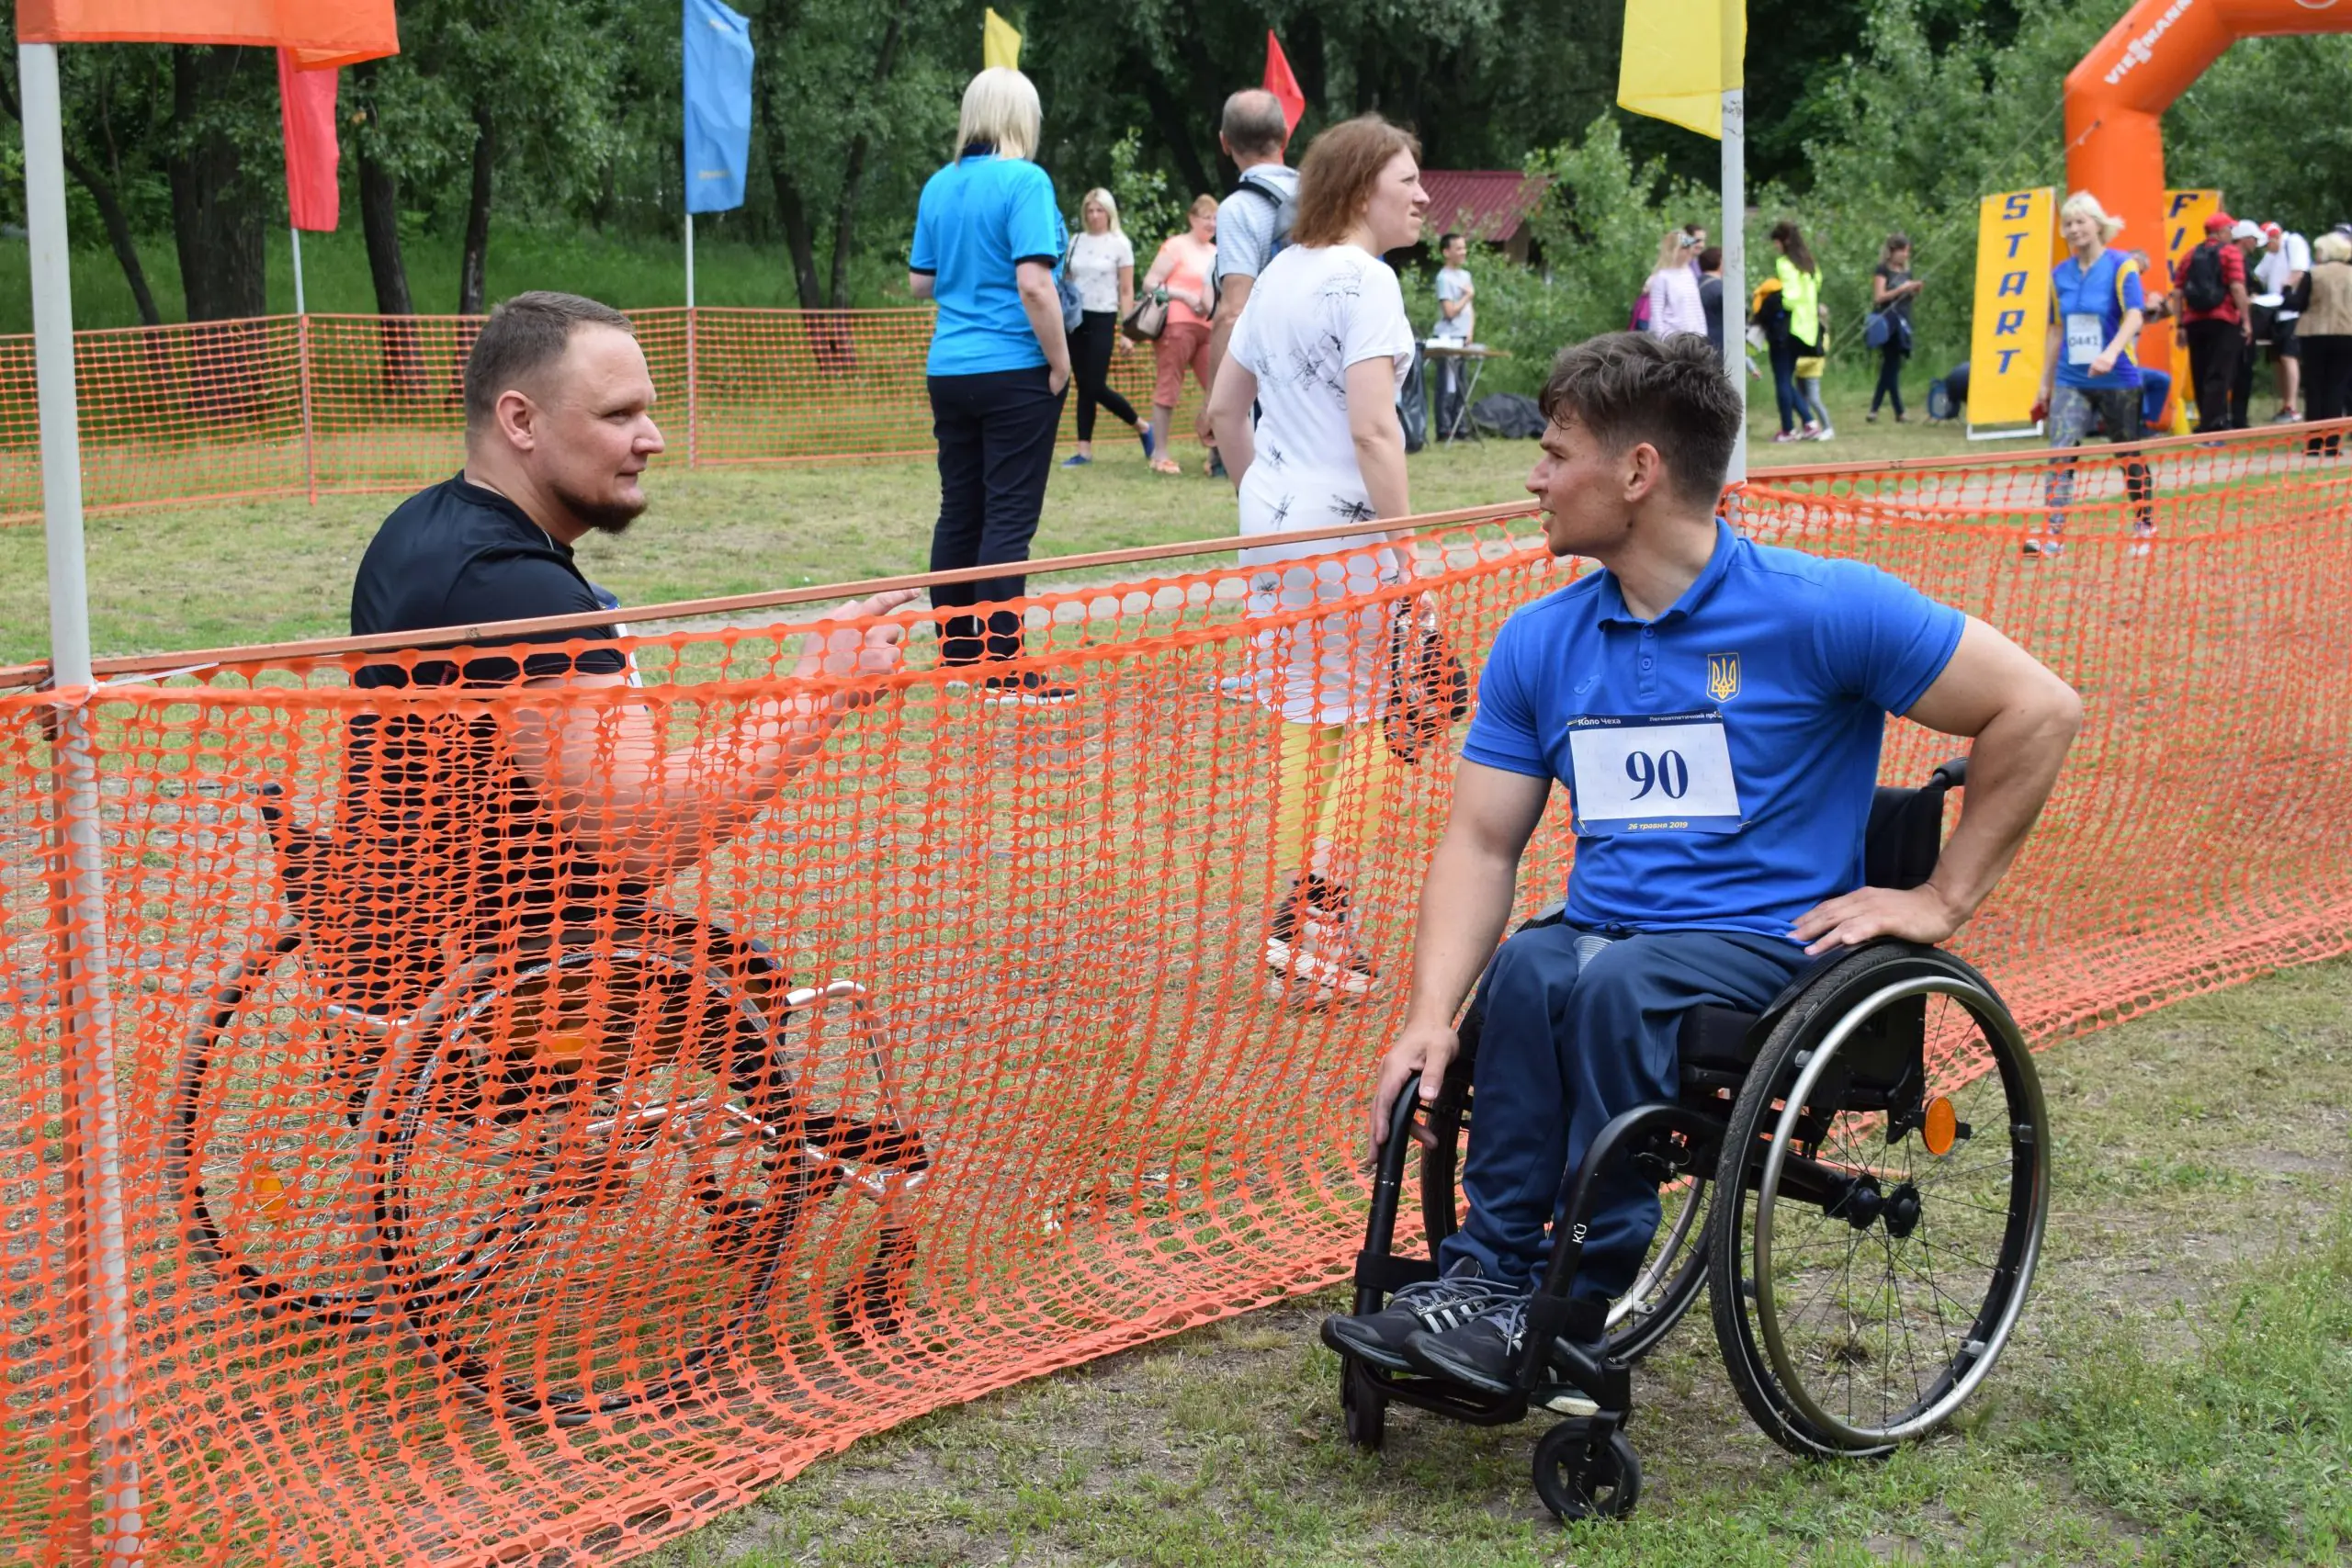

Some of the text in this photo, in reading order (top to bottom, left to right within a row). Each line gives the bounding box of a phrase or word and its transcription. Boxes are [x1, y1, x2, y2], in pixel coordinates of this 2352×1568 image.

[1996, 193, 2032, 375] START
[1577, 717, 1600, 726] Коло
[1625, 750, 1689, 801] 90
[1572, 1223, 1588, 1244] KÜ
